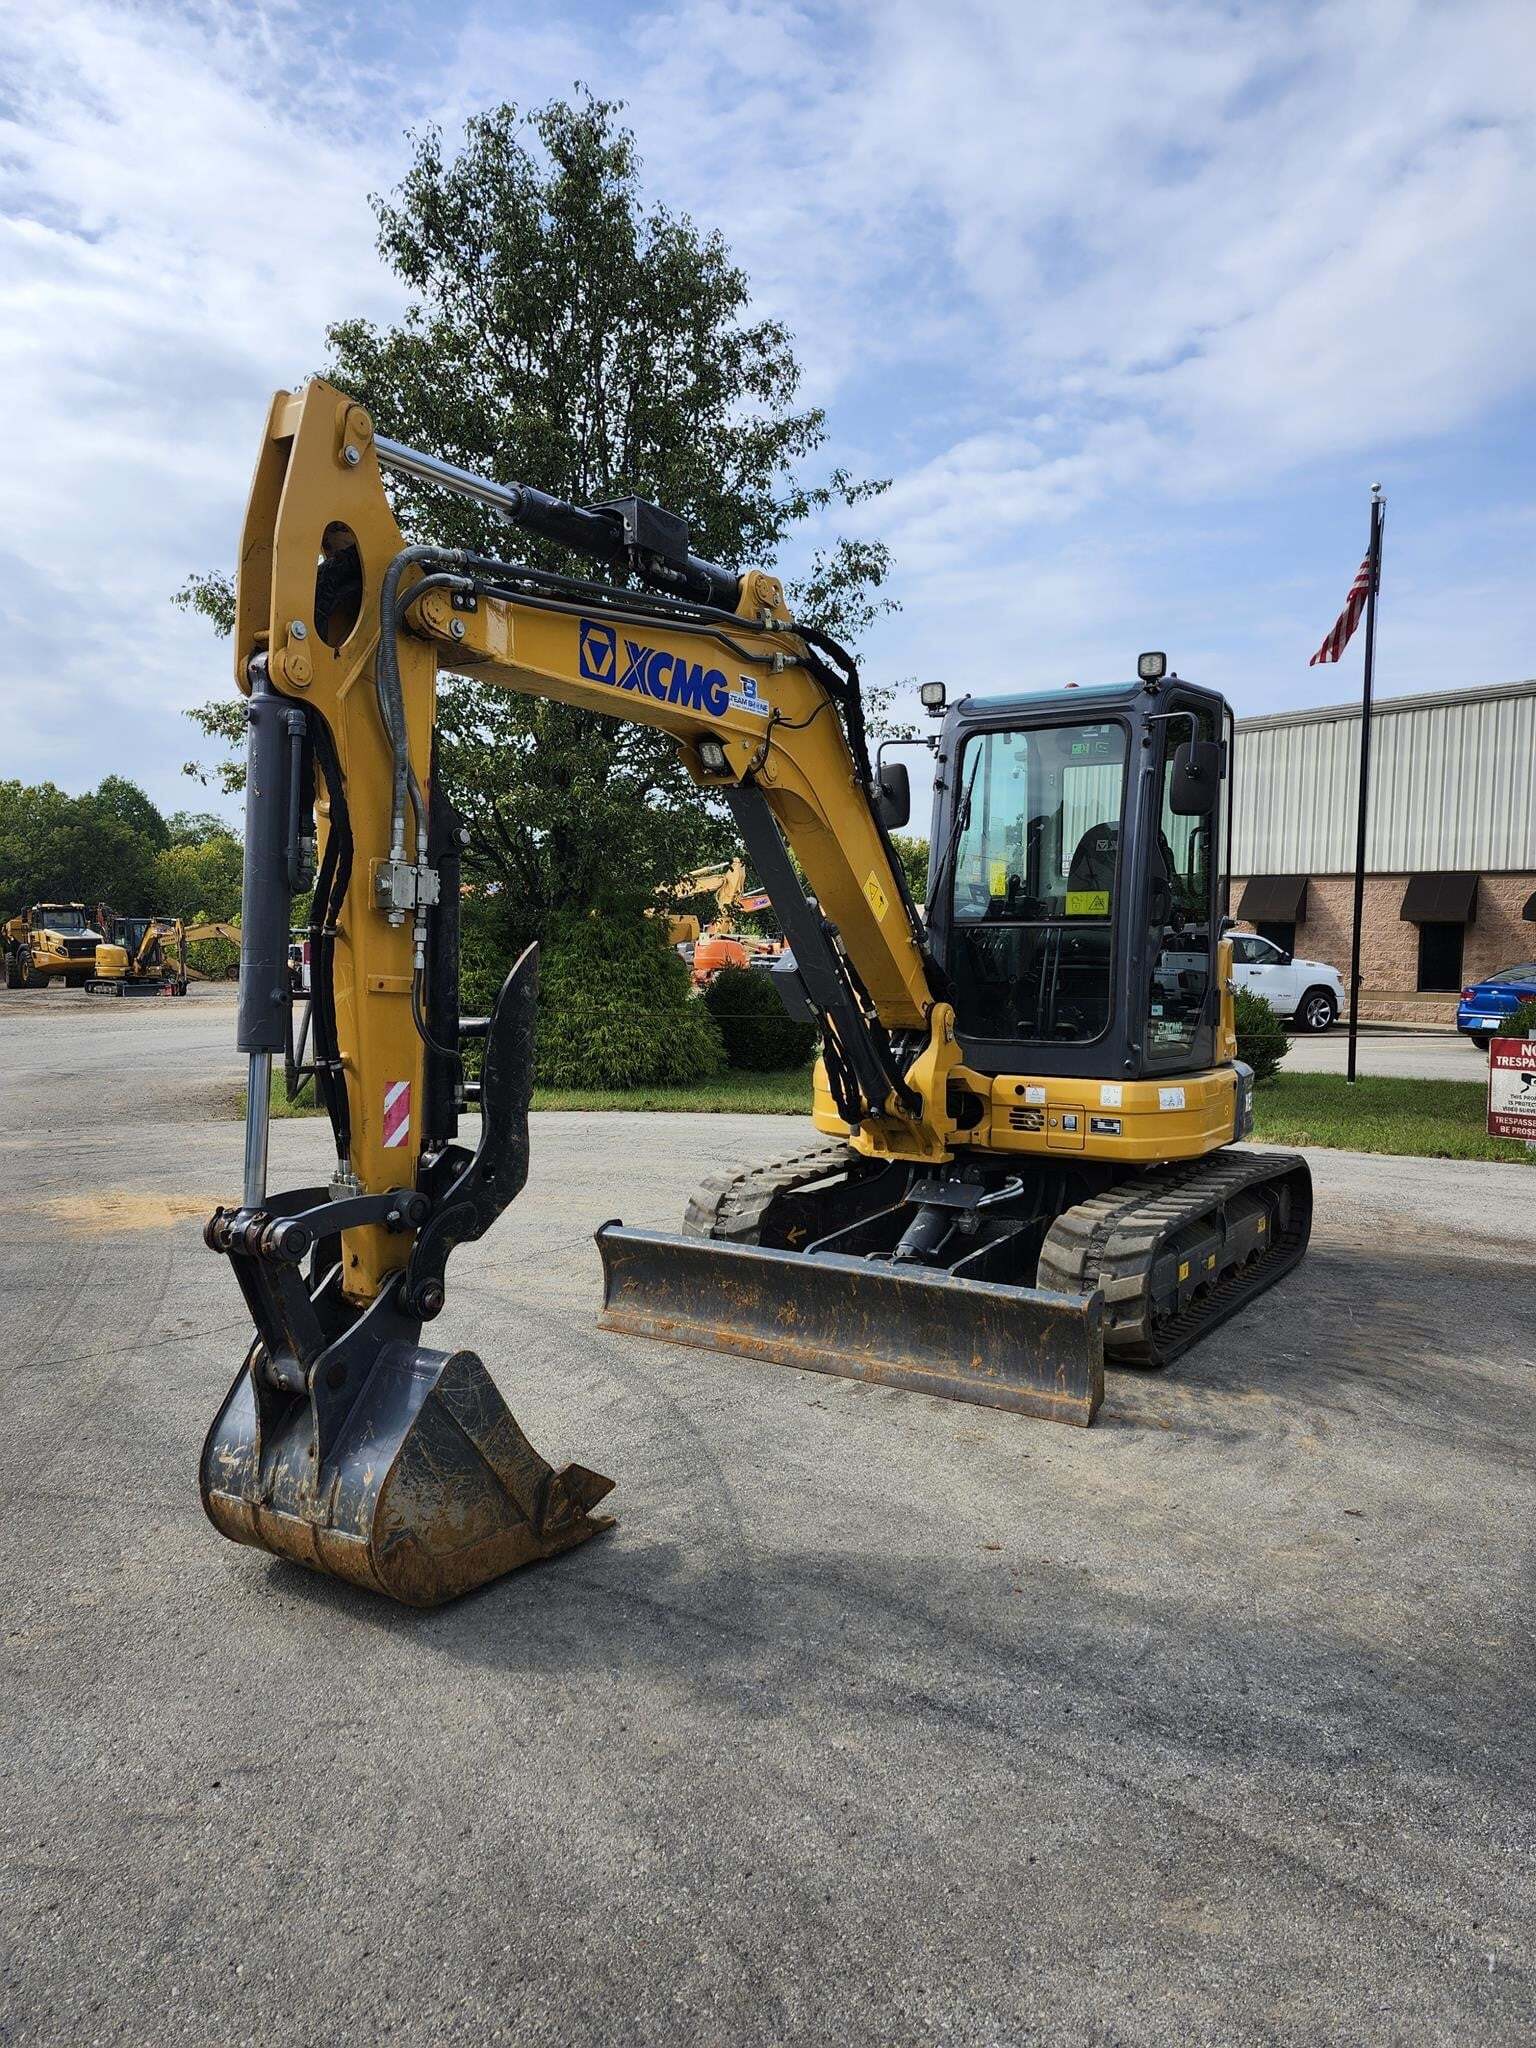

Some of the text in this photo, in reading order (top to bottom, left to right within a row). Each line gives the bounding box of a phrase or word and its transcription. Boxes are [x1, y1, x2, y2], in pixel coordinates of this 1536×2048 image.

[616, 639, 729, 717] XCMG
[730, 694, 748, 705] TEAM
[1500, 1125, 1510, 1134] BE
